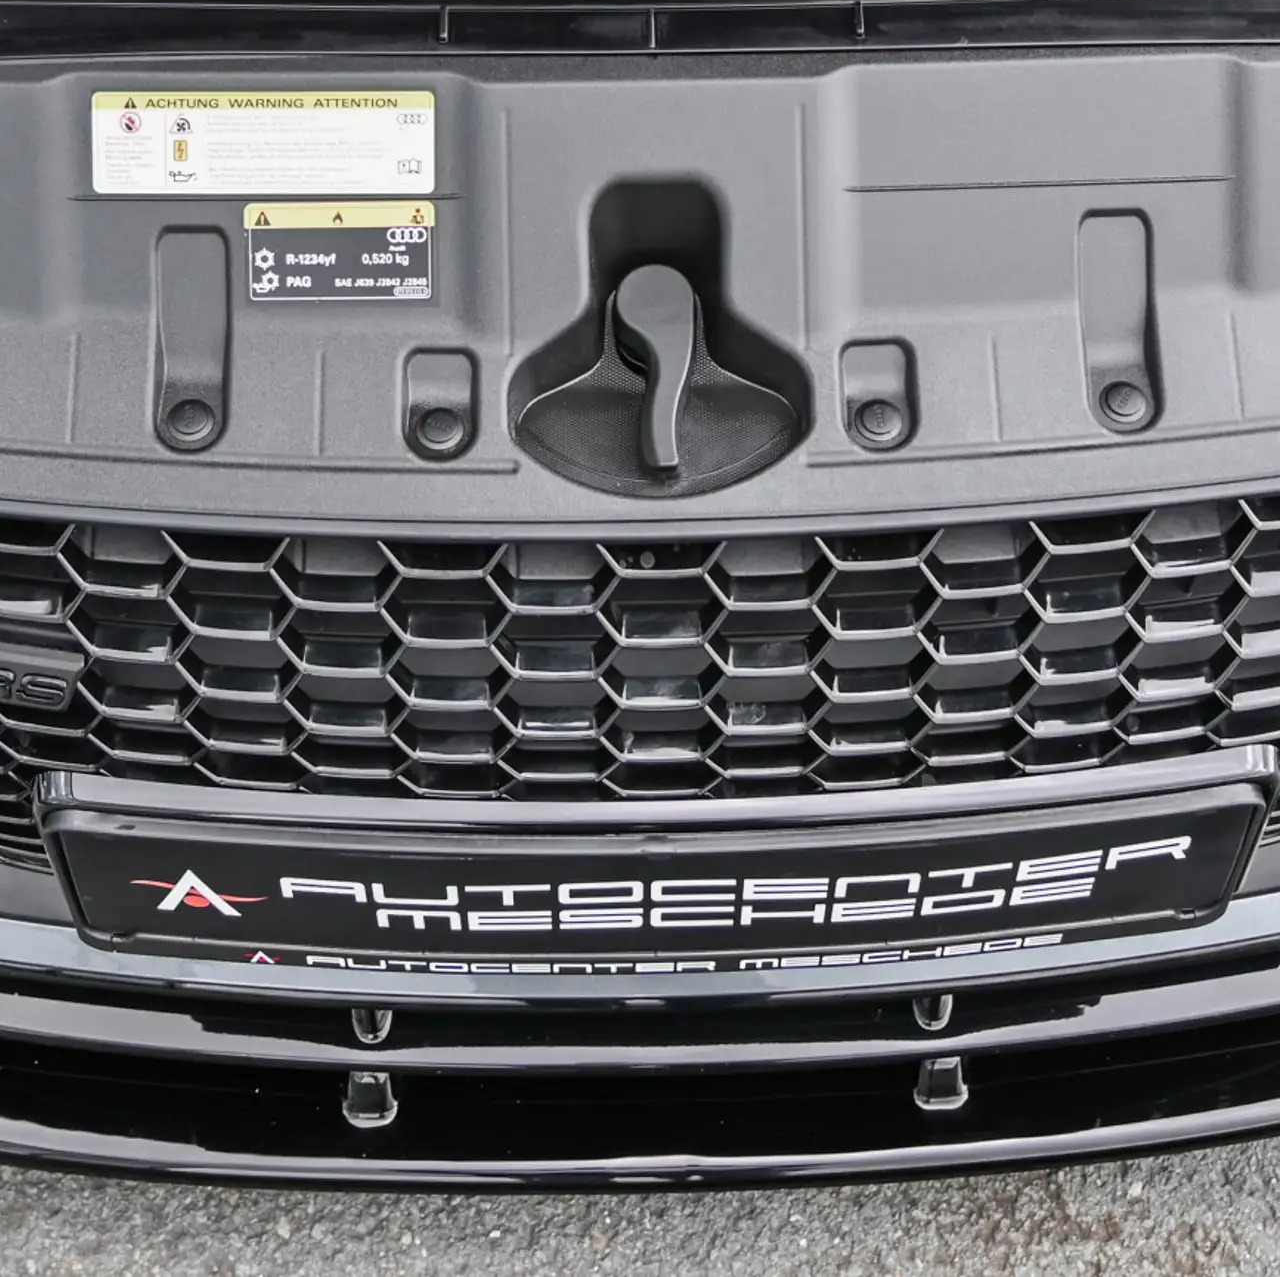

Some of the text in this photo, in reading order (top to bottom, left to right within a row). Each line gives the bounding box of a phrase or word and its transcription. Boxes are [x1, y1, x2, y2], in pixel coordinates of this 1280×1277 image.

[145, 97, 398, 109] ACHTUNG WARNING ATTENTION
[285, 253, 337, 267] R-1234yf
[395, 253, 410, 266] kg
[286, 276, 312, 288] PAG
[334, 278, 353, 287] SAE
[279, 835, 1192, 906] AUTOCENTER
[376, 877, 1096, 931] MESCHEDE
[306, 933, 1063, 974] AUTOCENTER MESCHEDE
